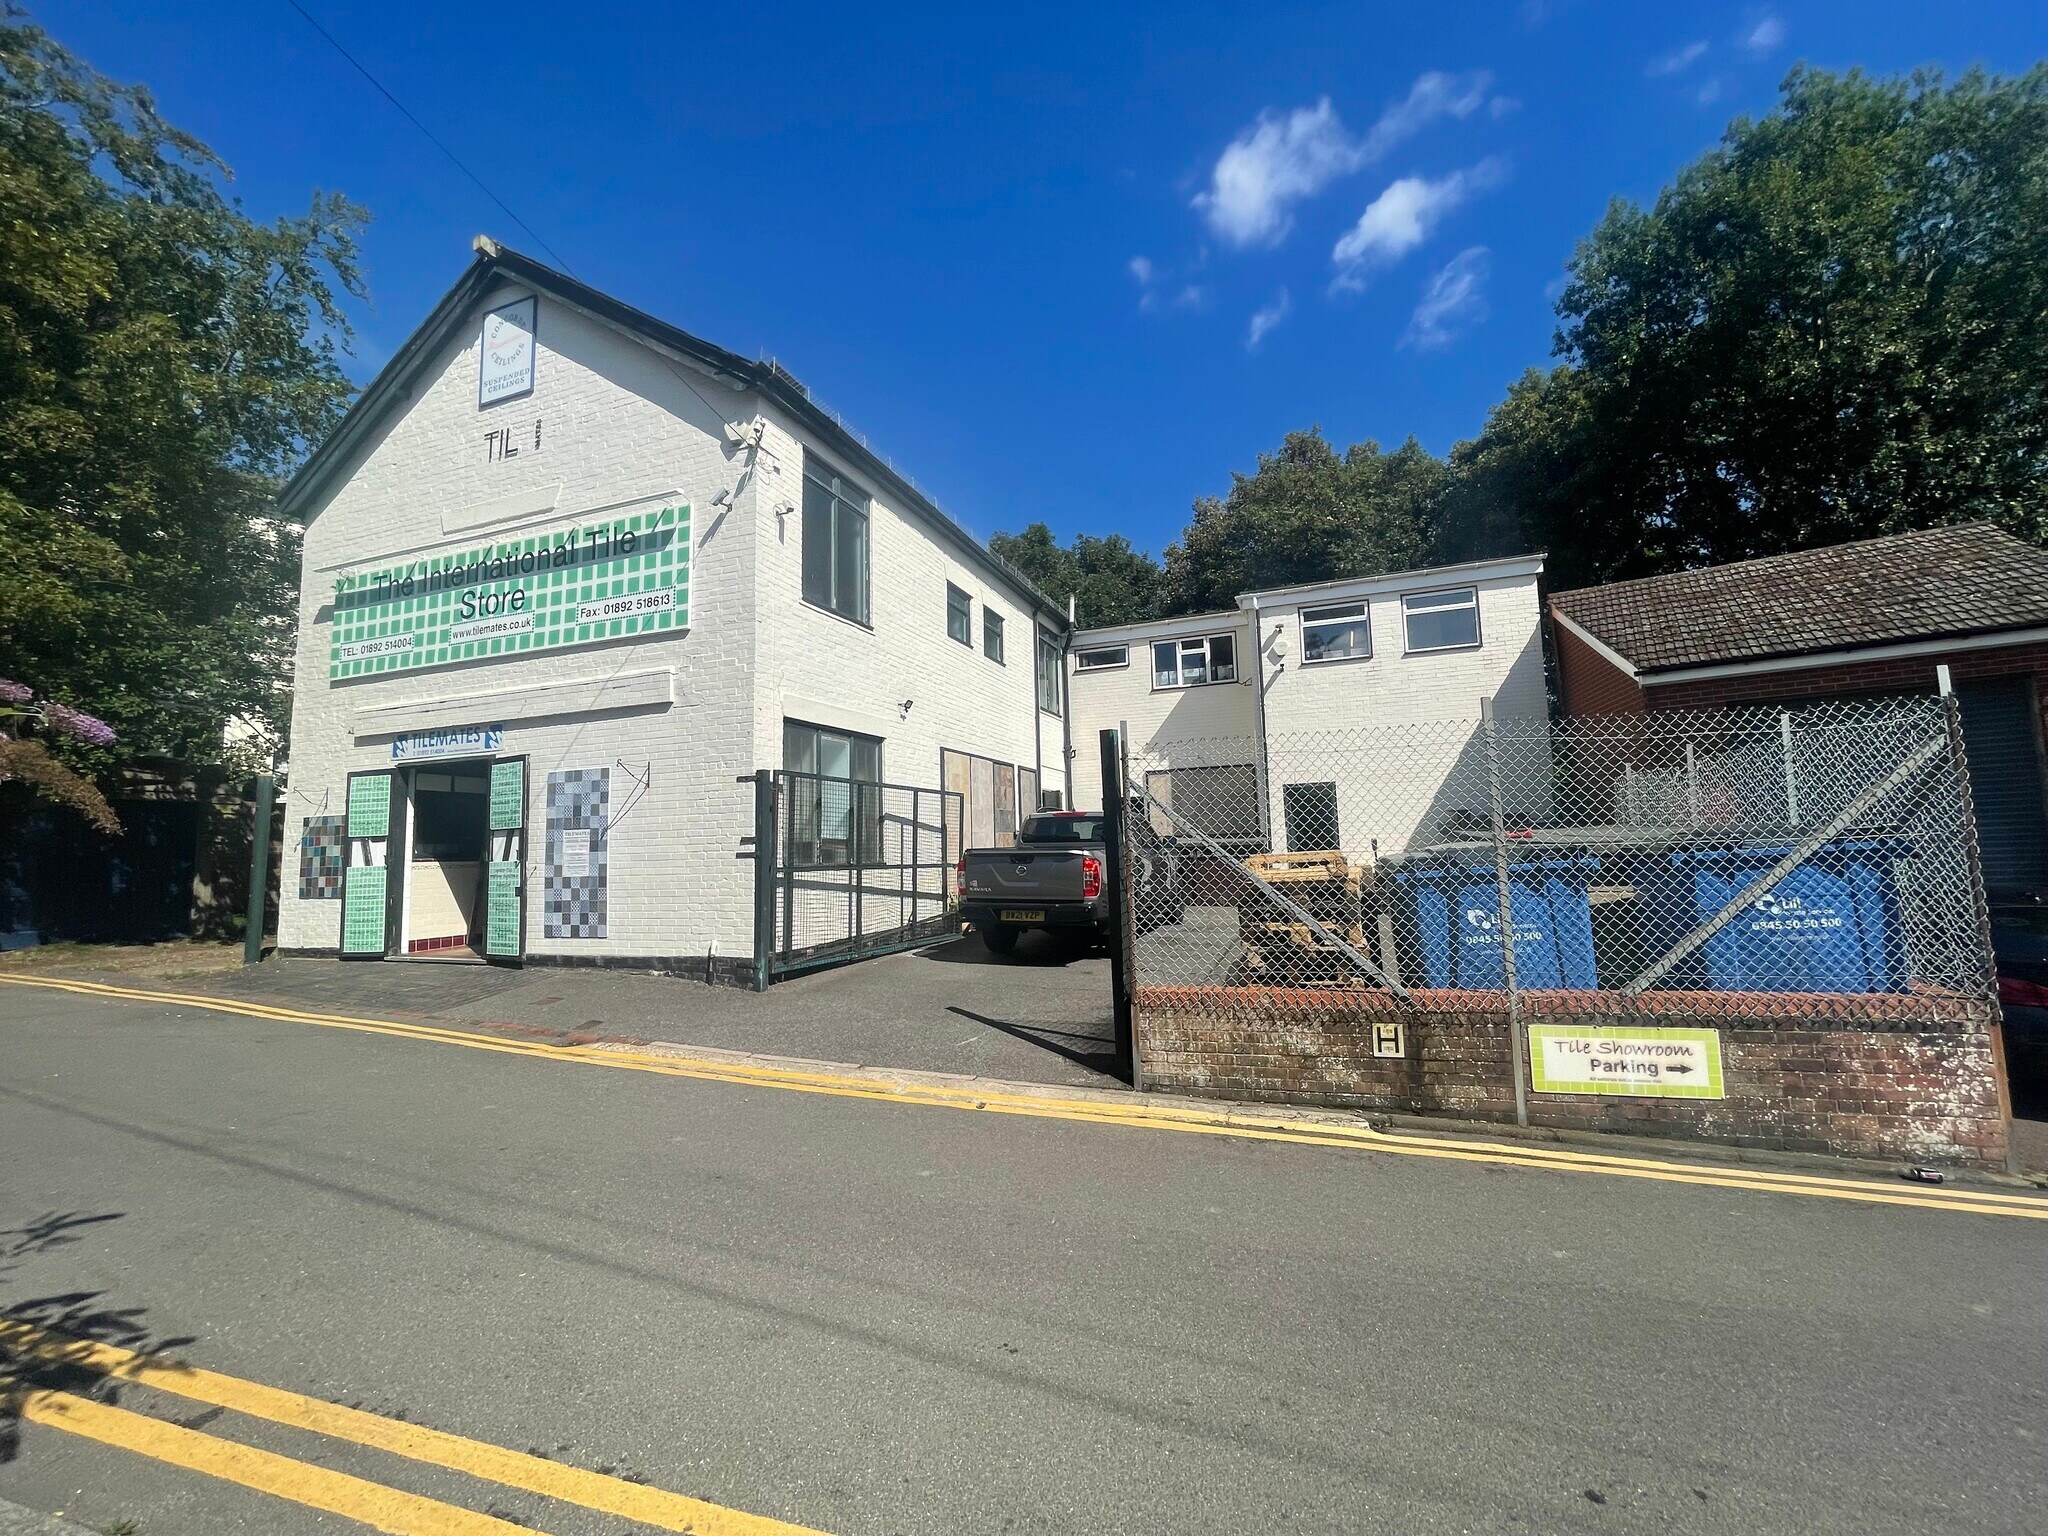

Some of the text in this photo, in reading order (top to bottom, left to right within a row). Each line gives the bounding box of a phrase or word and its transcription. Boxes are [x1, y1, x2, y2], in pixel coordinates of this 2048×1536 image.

[490, 342, 525, 368] CEILINGS
[483, 367, 530, 388] SUSPENDED
[487, 376, 525, 394] CEILINGS
[374, 526, 636, 601] The International Tile
[461, 588, 525, 620] Store
[580, 593, 670, 618] Fax: 01892 518613
[452, 618, 531, 639] www.tilemates.co.uk
[343, 637, 412, 657] TEL: 01892 514004
[411, 726, 481, 749] TILEMATES
[1785, 920, 1800, 929] 50
[1803, 919, 1818, 928] 50
[1820, 917, 1842, 927] 500
[1524, 931, 1542, 940] 500
[1376, 1026, 1400, 1053] H
[1554, 1040, 1693, 1056] Tile Showroom
[1590, 1058, 1659, 1077] Parking
